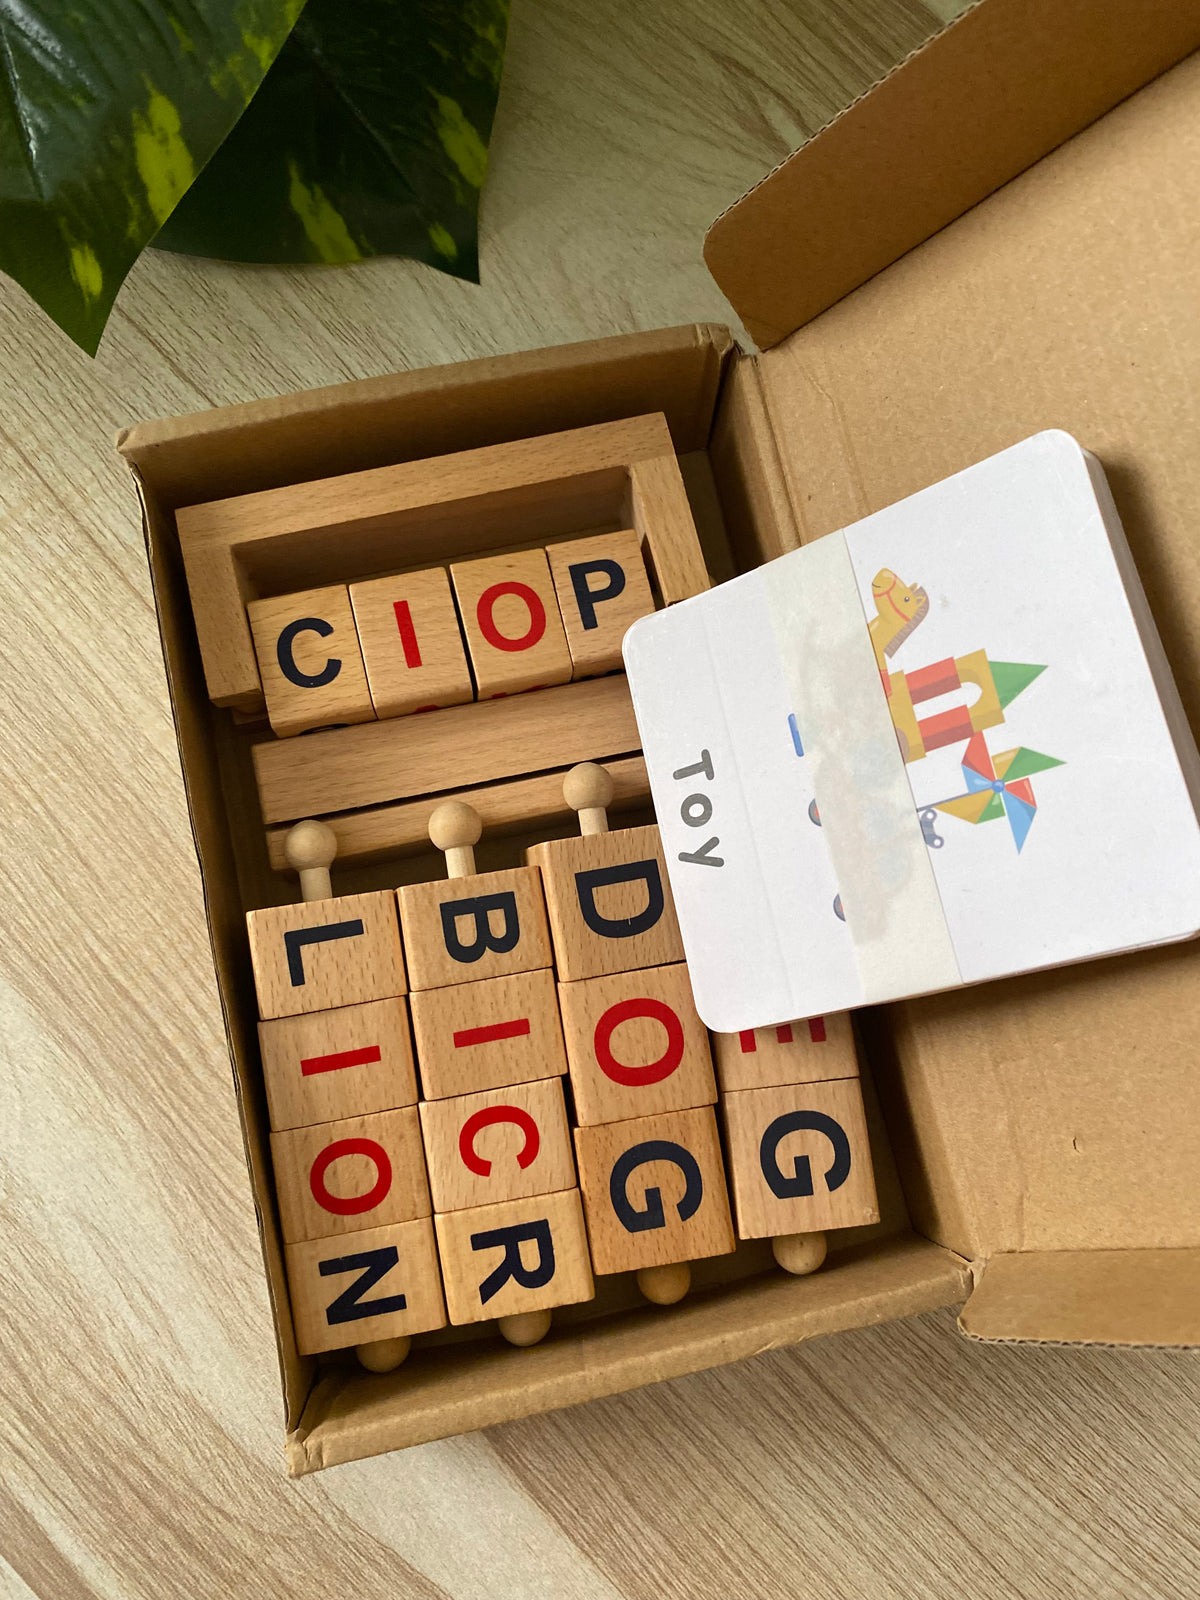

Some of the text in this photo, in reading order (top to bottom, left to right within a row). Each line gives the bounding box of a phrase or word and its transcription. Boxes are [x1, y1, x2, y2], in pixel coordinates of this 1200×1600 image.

[277, 557, 626, 688] CIOP
[672, 748, 725, 868] Toy
[284, 919, 407, 1325] LION
[439, 891, 555, 1305] BICR
[574, 858, 703, 1233] DOG
